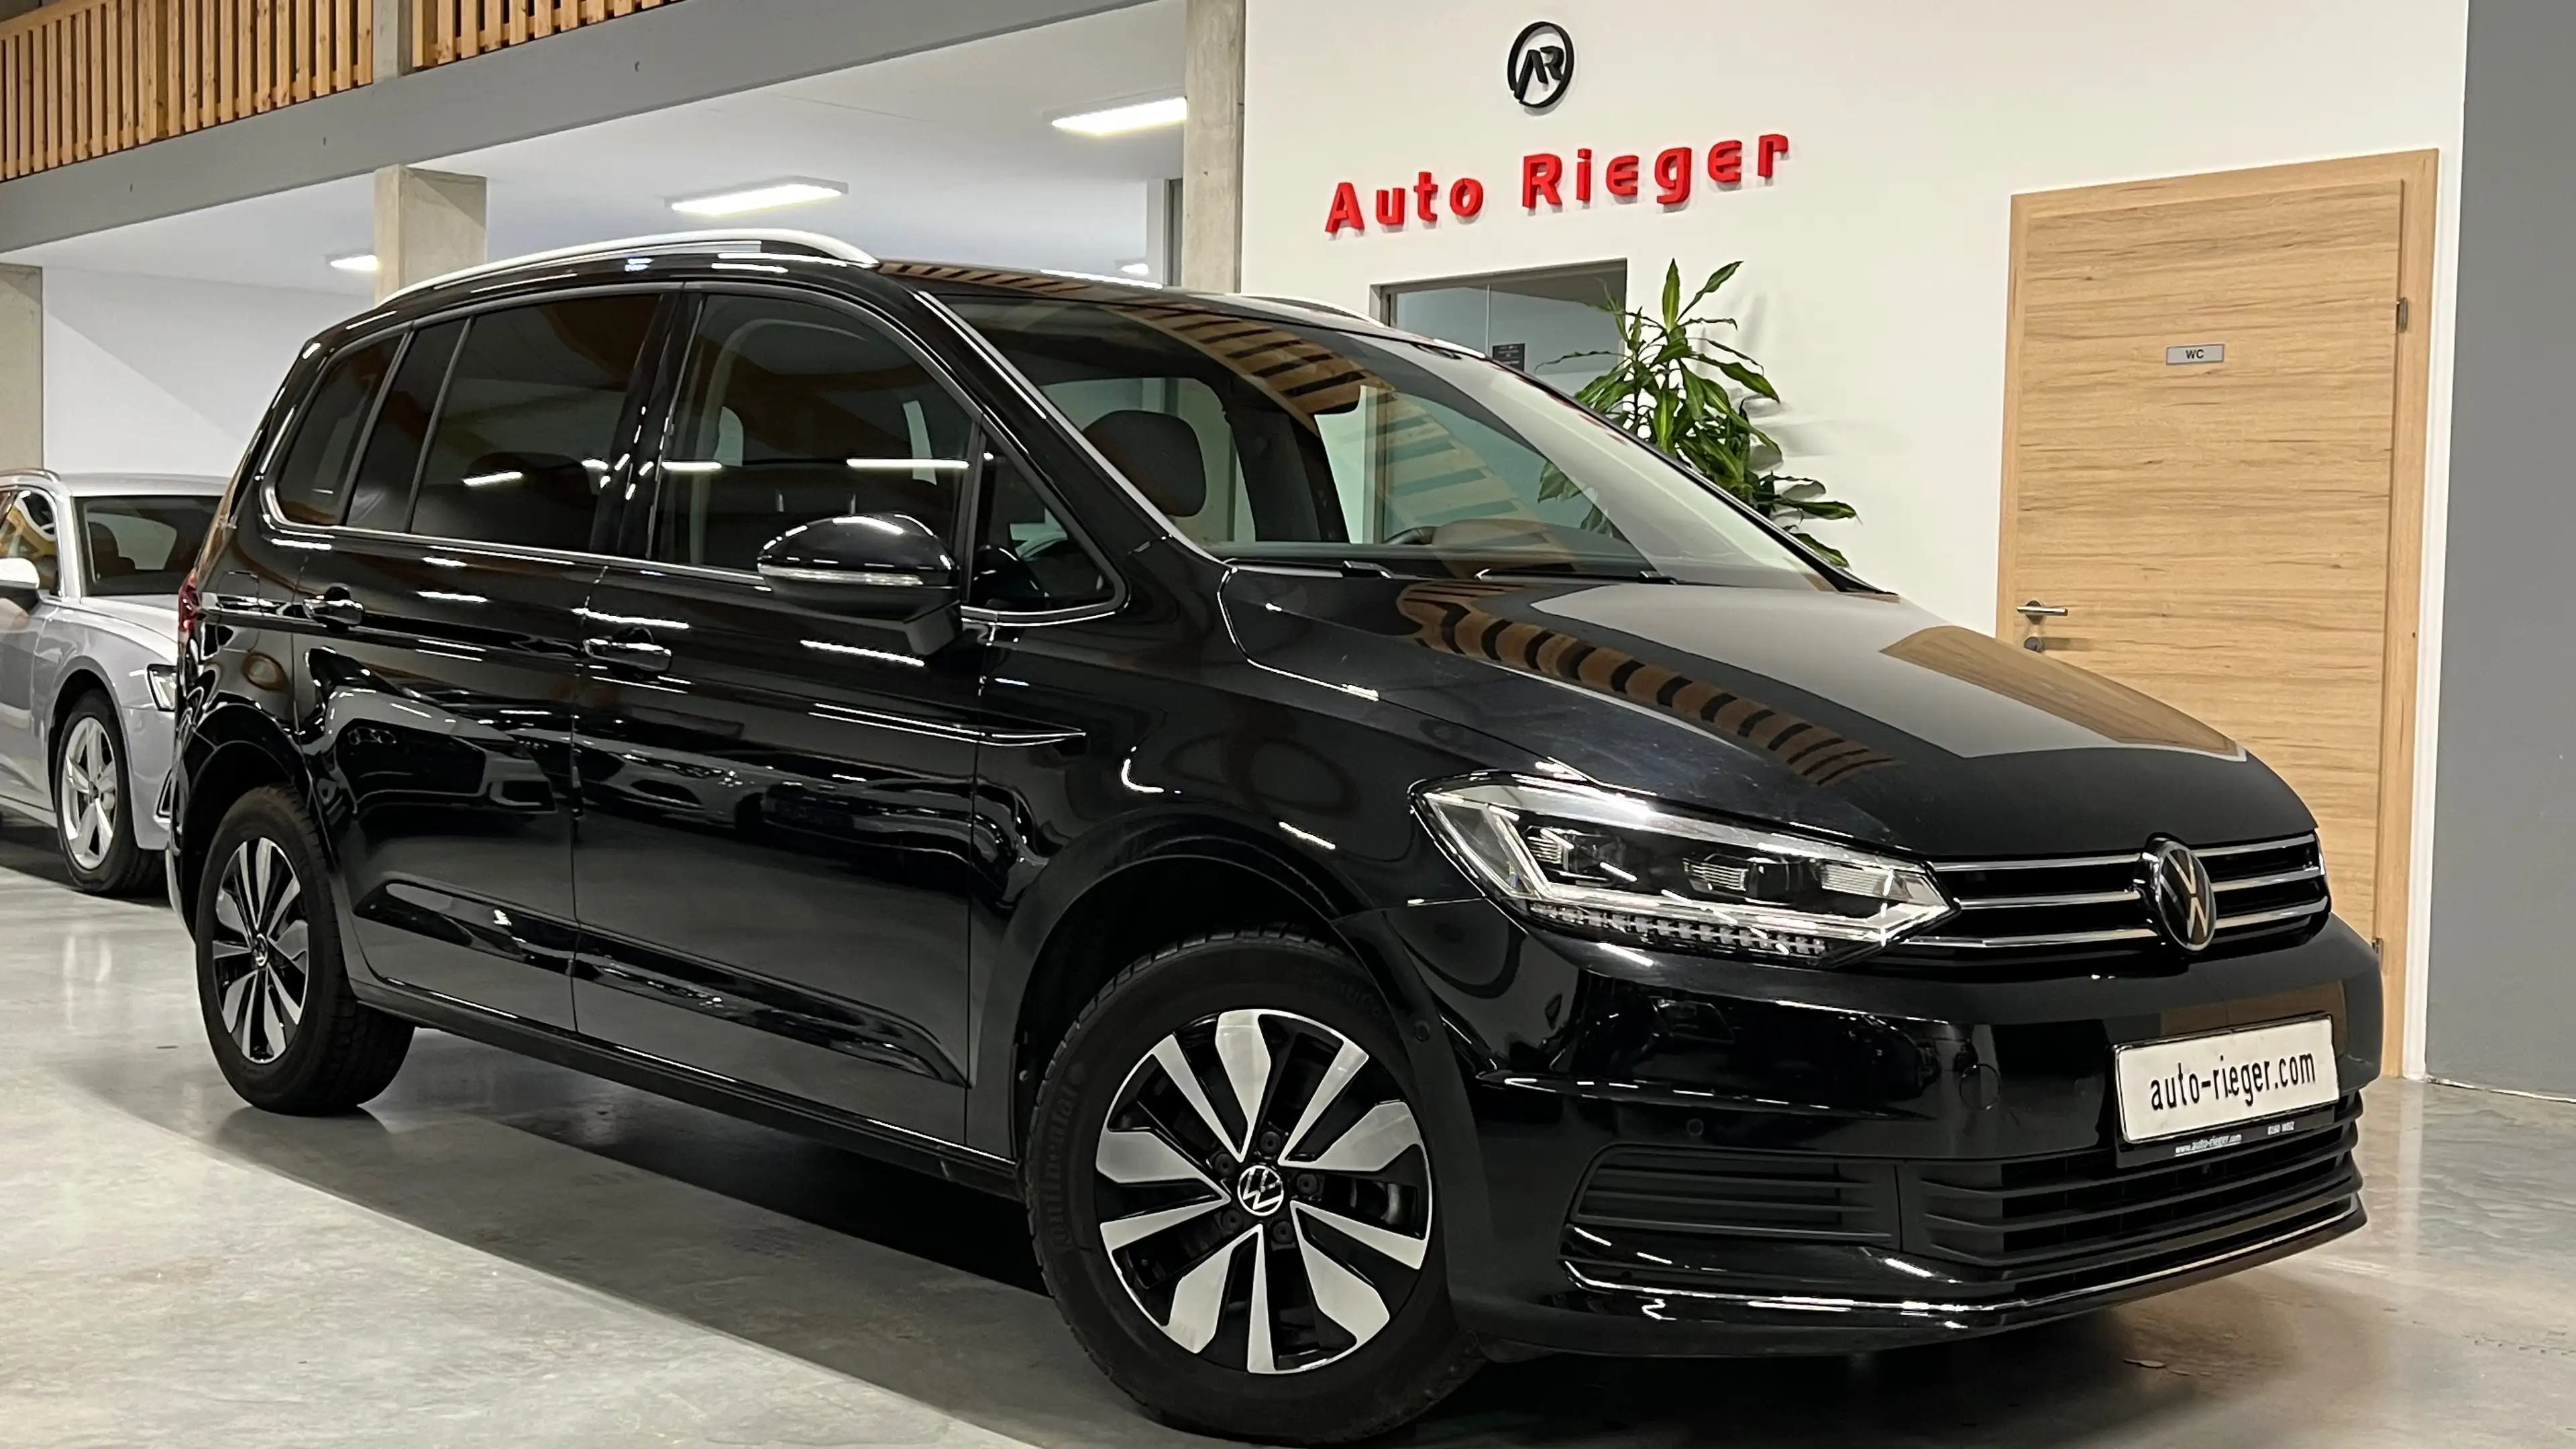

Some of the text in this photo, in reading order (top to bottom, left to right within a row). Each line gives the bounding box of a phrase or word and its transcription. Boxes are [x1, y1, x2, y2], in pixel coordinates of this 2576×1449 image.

[1325, 133, 1789, 234] Auto Rieger
[2184, 349, 2205, 360] WC
[2150, 1053, 2317, 1111] auto-rieger.com
